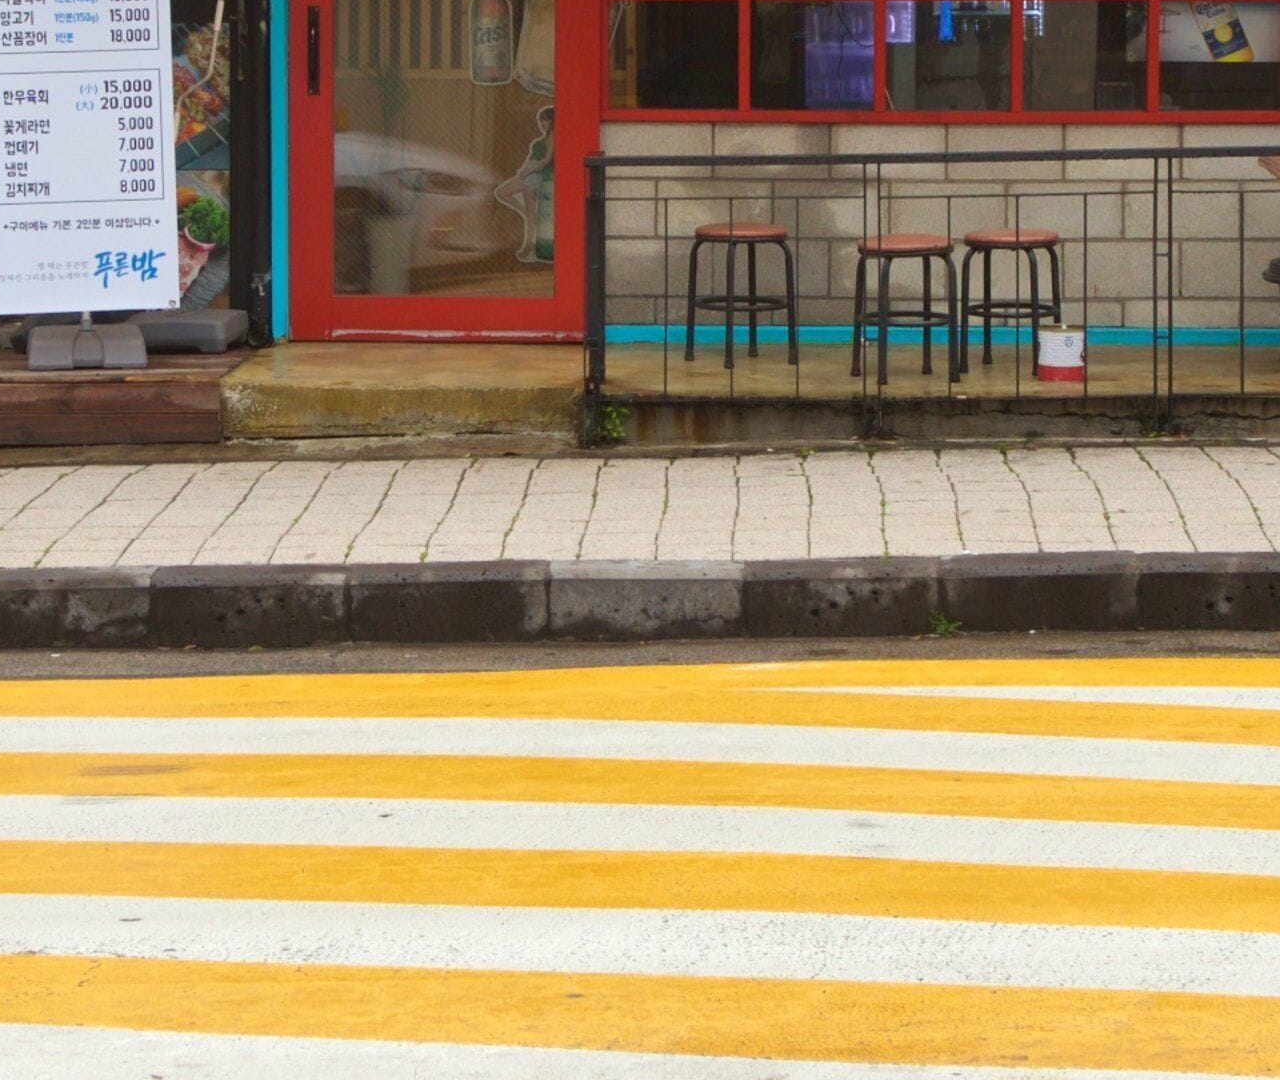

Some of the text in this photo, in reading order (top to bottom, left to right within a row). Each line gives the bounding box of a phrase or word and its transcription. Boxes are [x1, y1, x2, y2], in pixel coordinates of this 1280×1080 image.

[0, 10, 34, 26] 양고기
[3, 90, 50, 106] 한우육회
[3, 119, 51, 135] 꽃게라면
[4, 140, 40, 156] 껍데기
[5, 160, 29, 178] 냉면
[5, 181, 51, 198] 김치찌개
[53, 219, 73, 231] 기본
[75, 217, 102, 231] 2인분
[93, 249, 167, 290] 푸른밤
